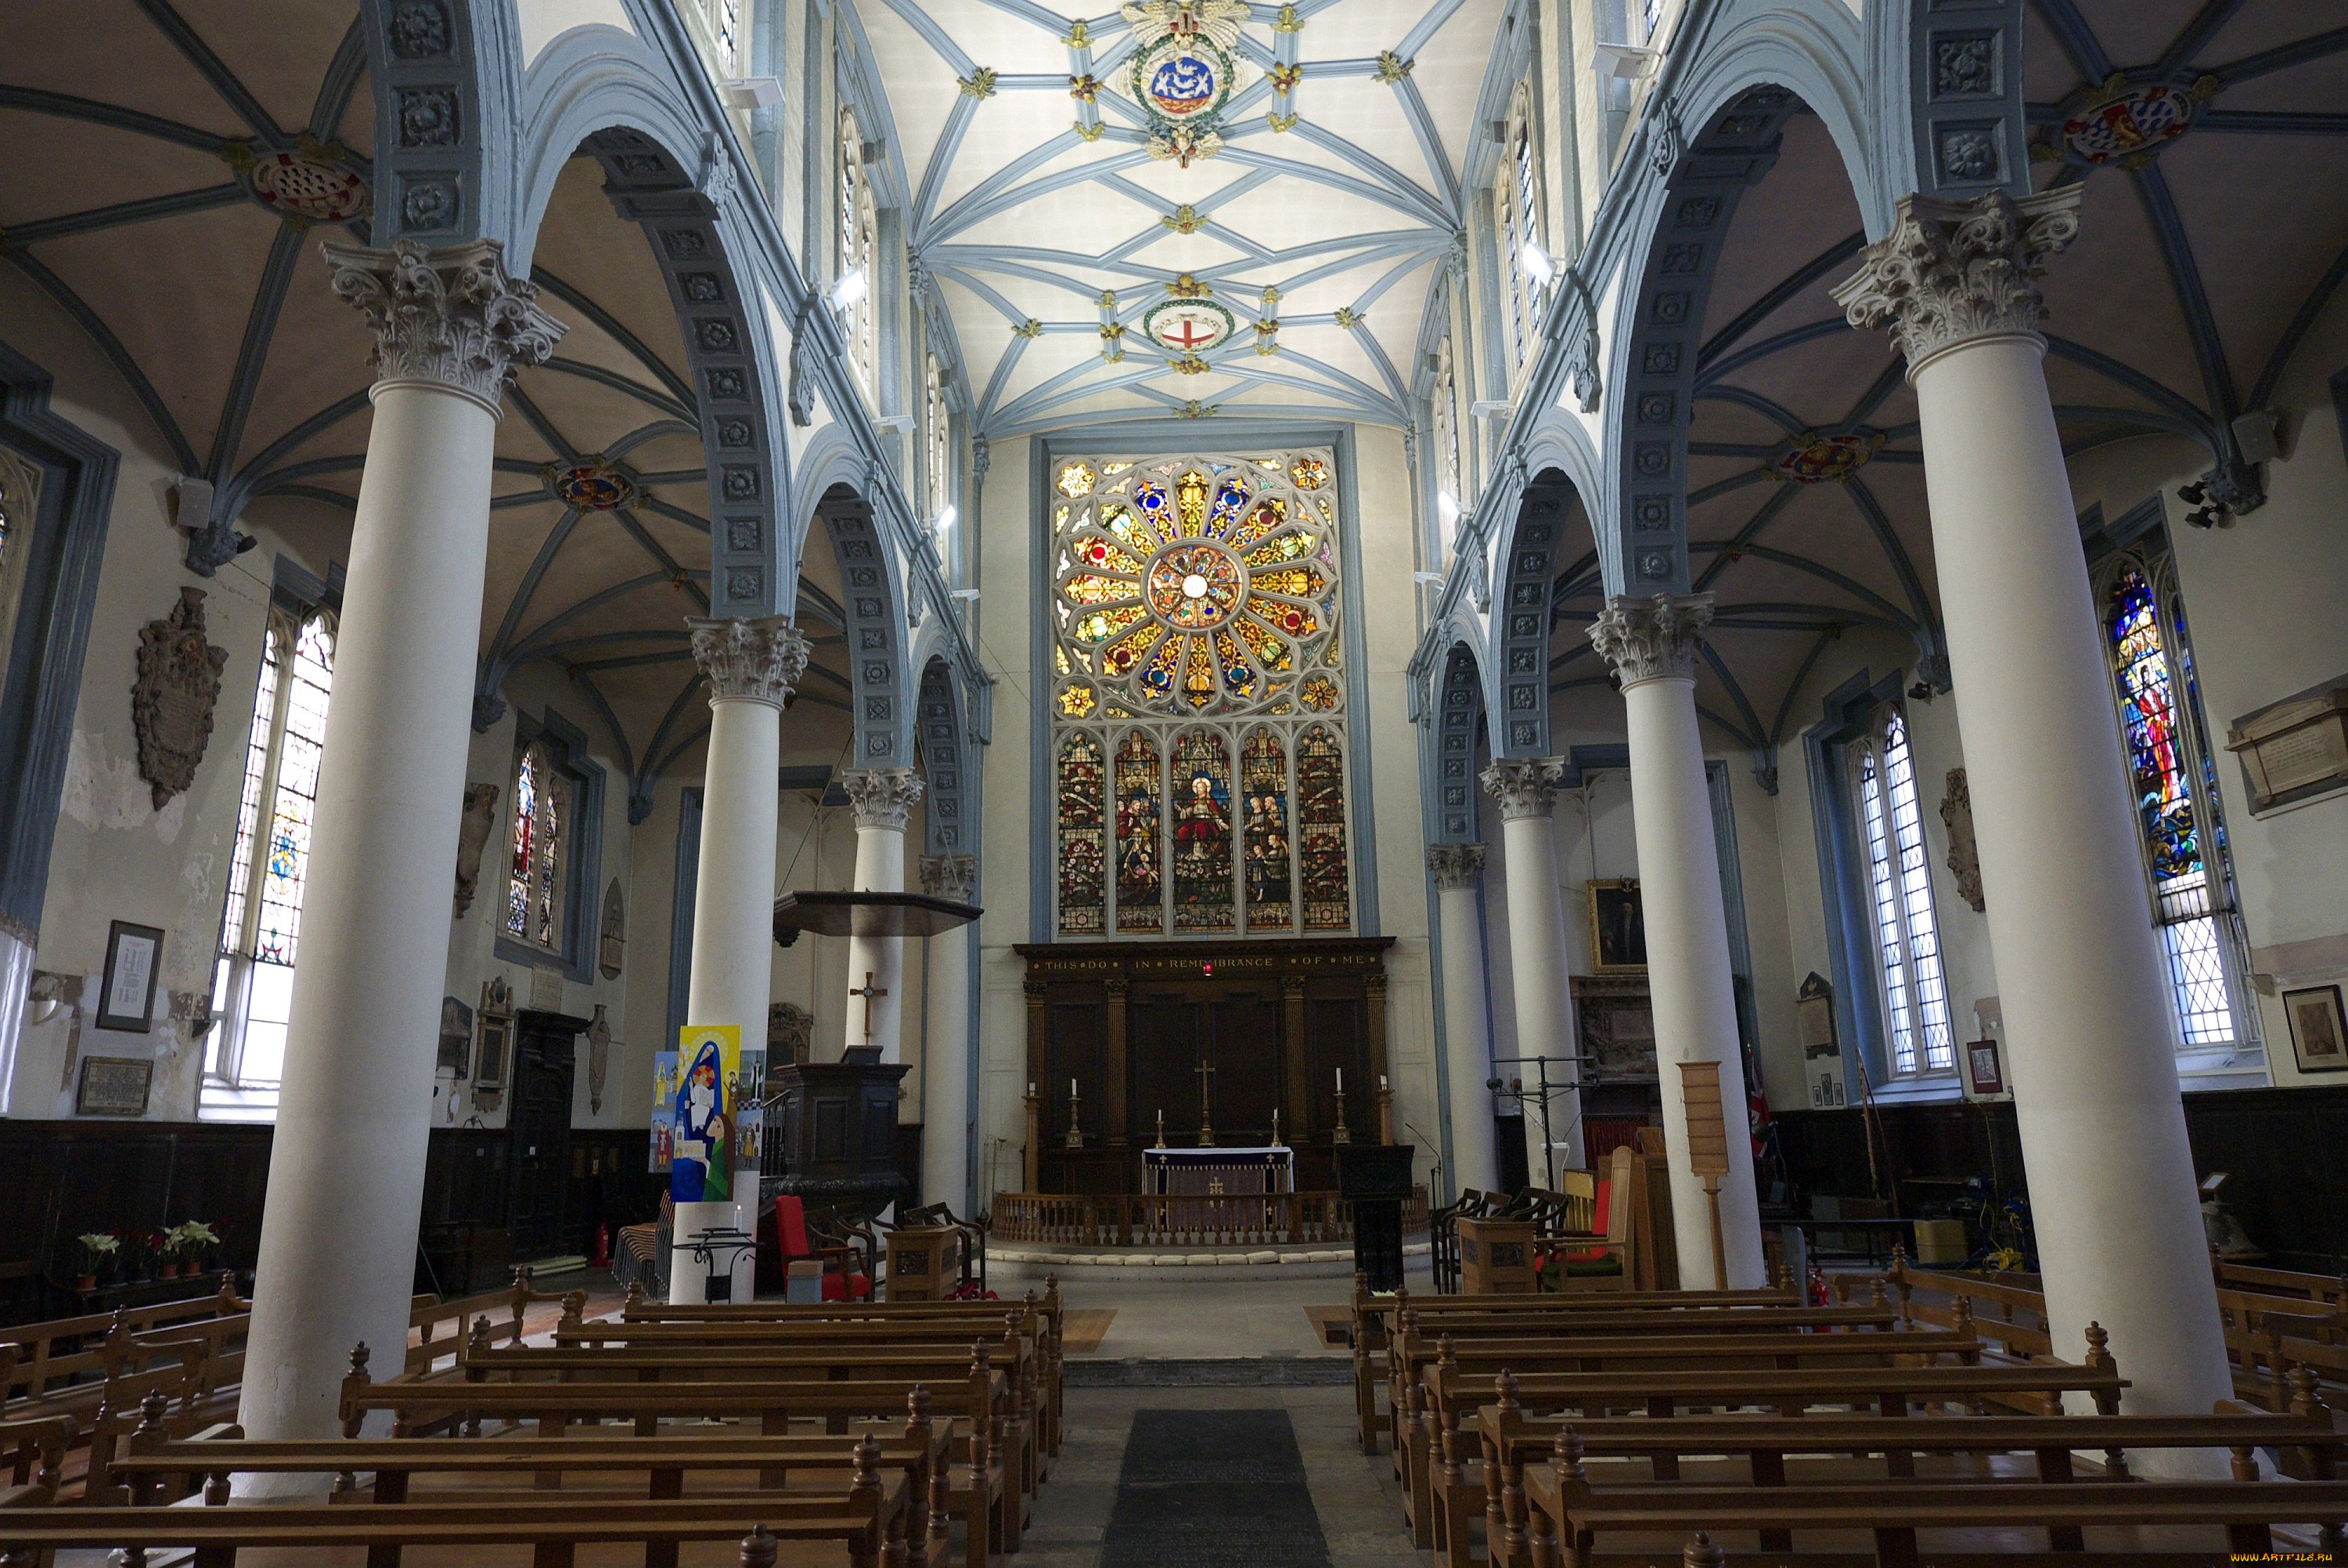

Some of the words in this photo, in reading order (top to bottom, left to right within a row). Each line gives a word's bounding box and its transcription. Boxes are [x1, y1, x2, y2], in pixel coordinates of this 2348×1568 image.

[1045, 961, 1077, 969] THIS
[1088, 960, 1107, 969] DO
[1136, 960, 1150, 969] IN
[1302, 956, 1323, 965] OF
[1342, 955, 1364, 964] ME
